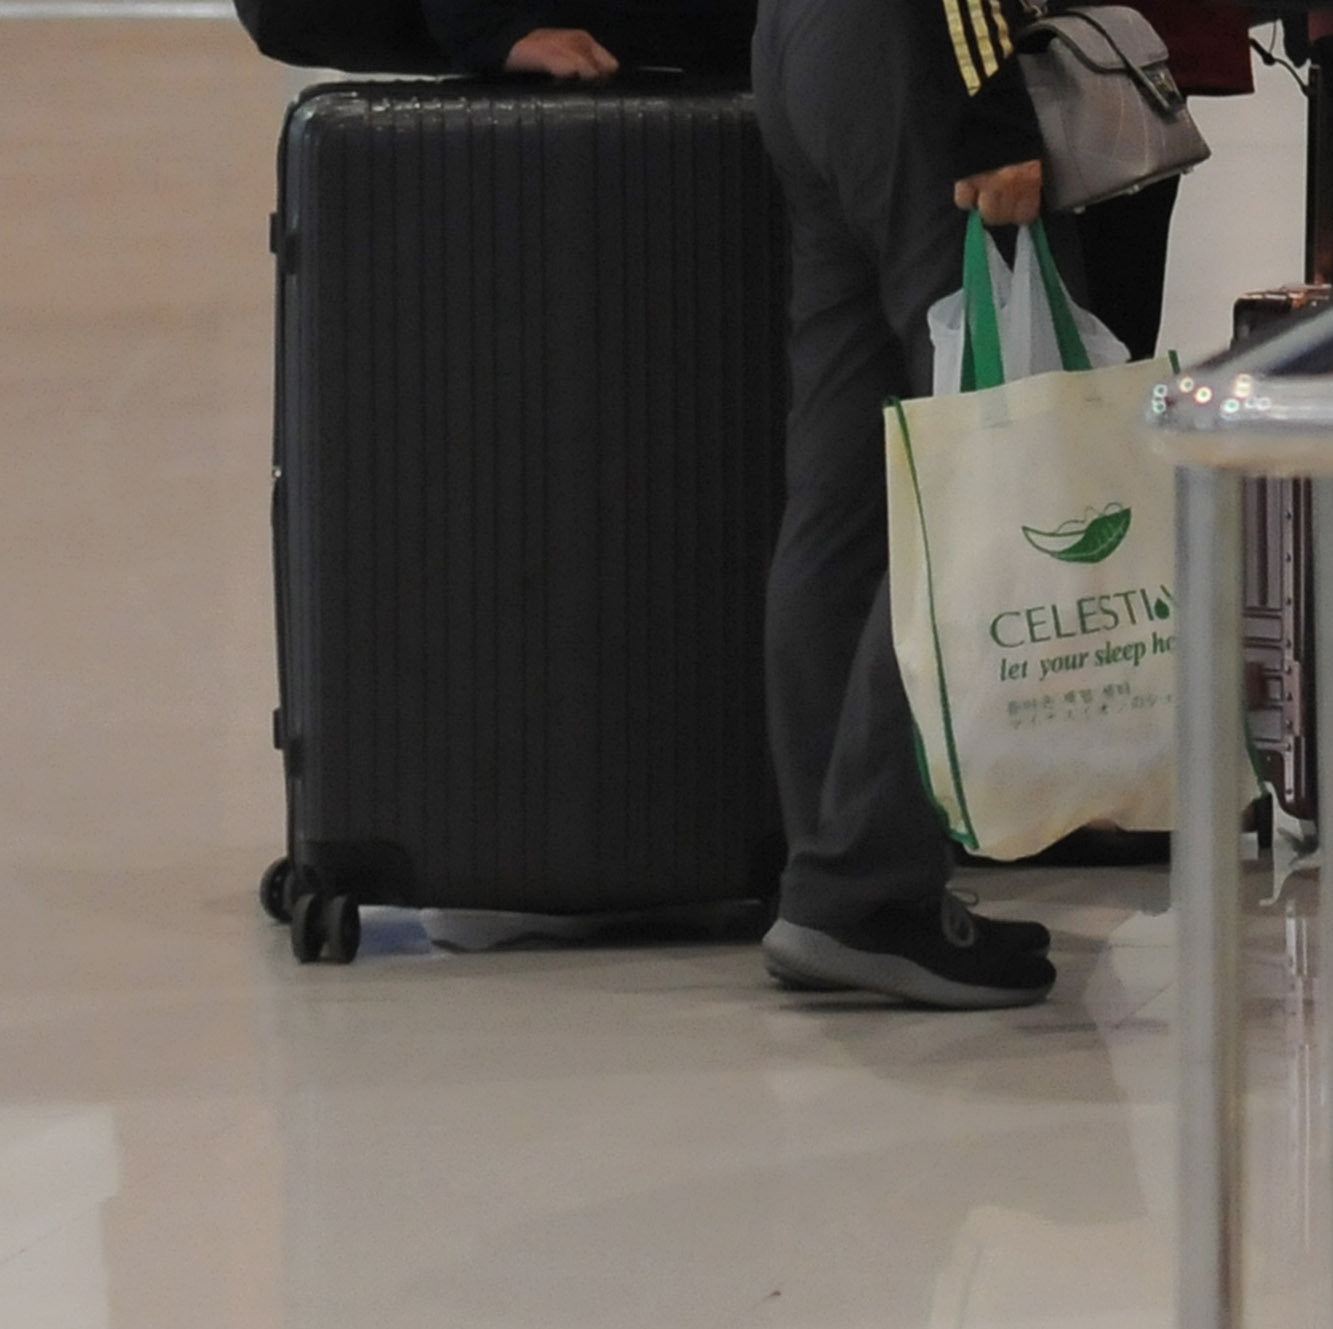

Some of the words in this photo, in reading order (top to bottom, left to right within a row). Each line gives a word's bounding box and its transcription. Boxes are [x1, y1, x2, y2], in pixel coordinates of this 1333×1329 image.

[1000, 658, 1029, 682] let
[1039, 650, 1091, 682] your
[1094, 640, 1147, 667] sleep
